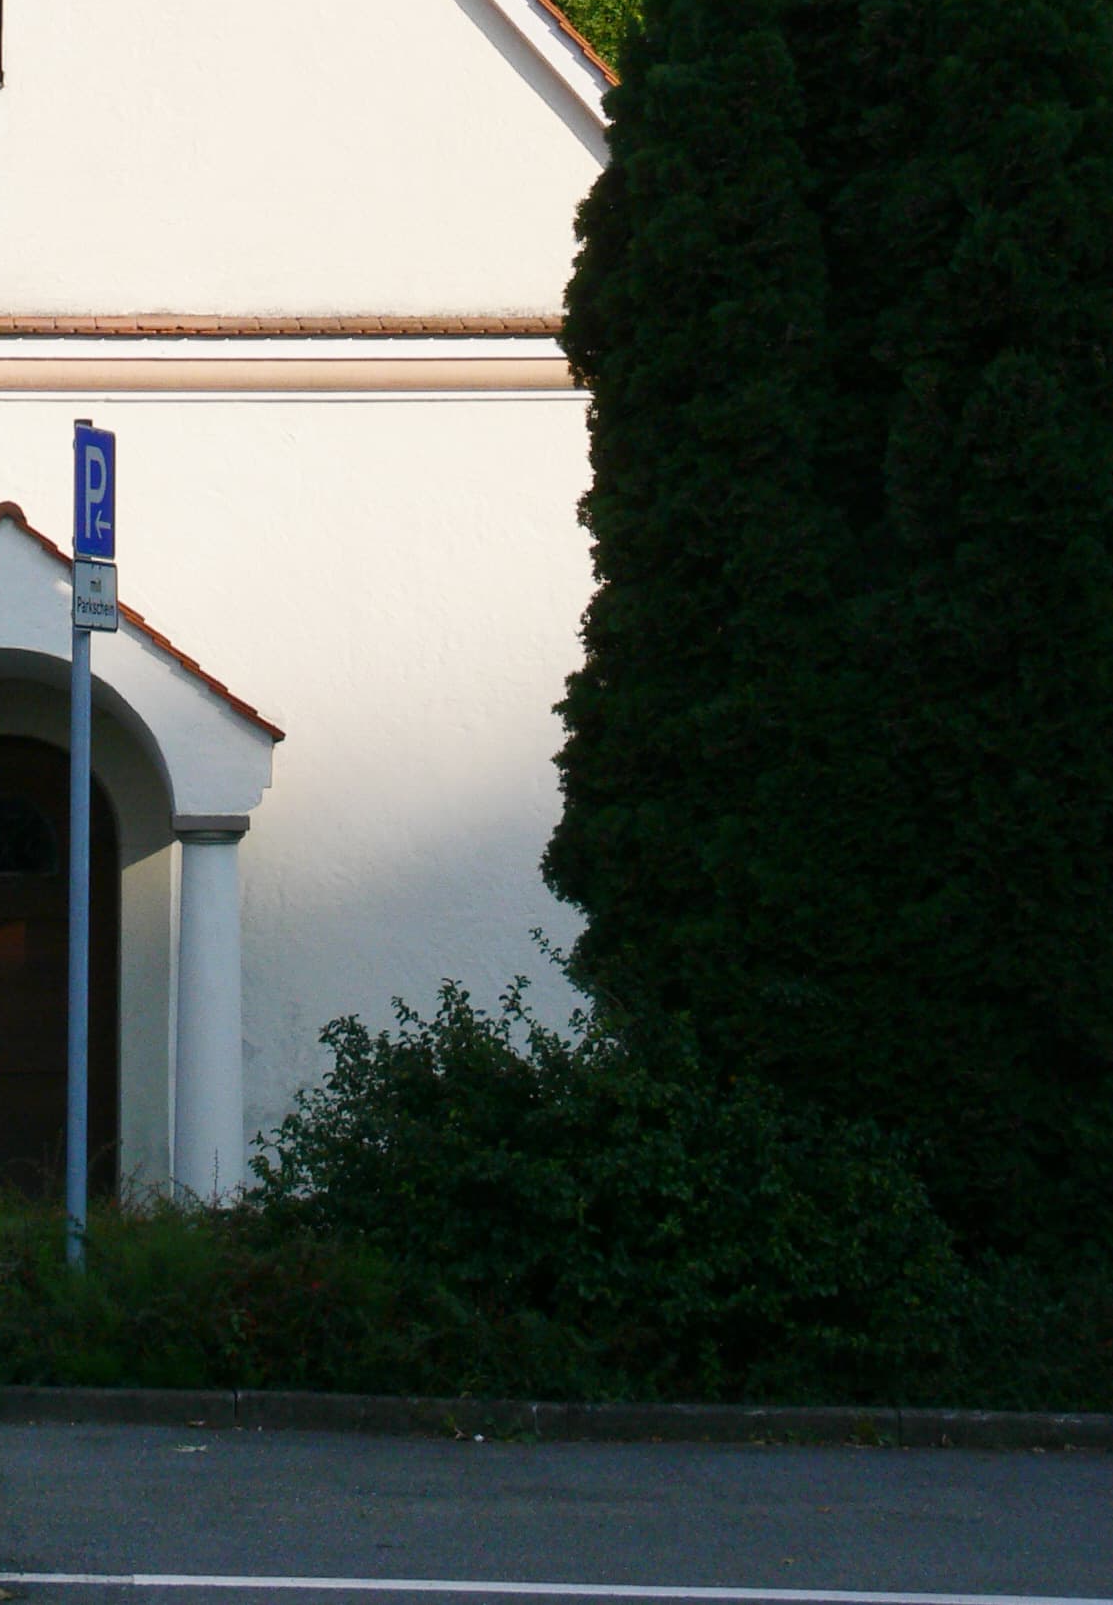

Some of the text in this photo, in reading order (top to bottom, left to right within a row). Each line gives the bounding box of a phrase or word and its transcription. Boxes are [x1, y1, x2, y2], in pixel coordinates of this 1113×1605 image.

[85, 444, 107, 538] P
[89, 579, 102, 592] mit
[77, 596, 115, 616] Parkschein
